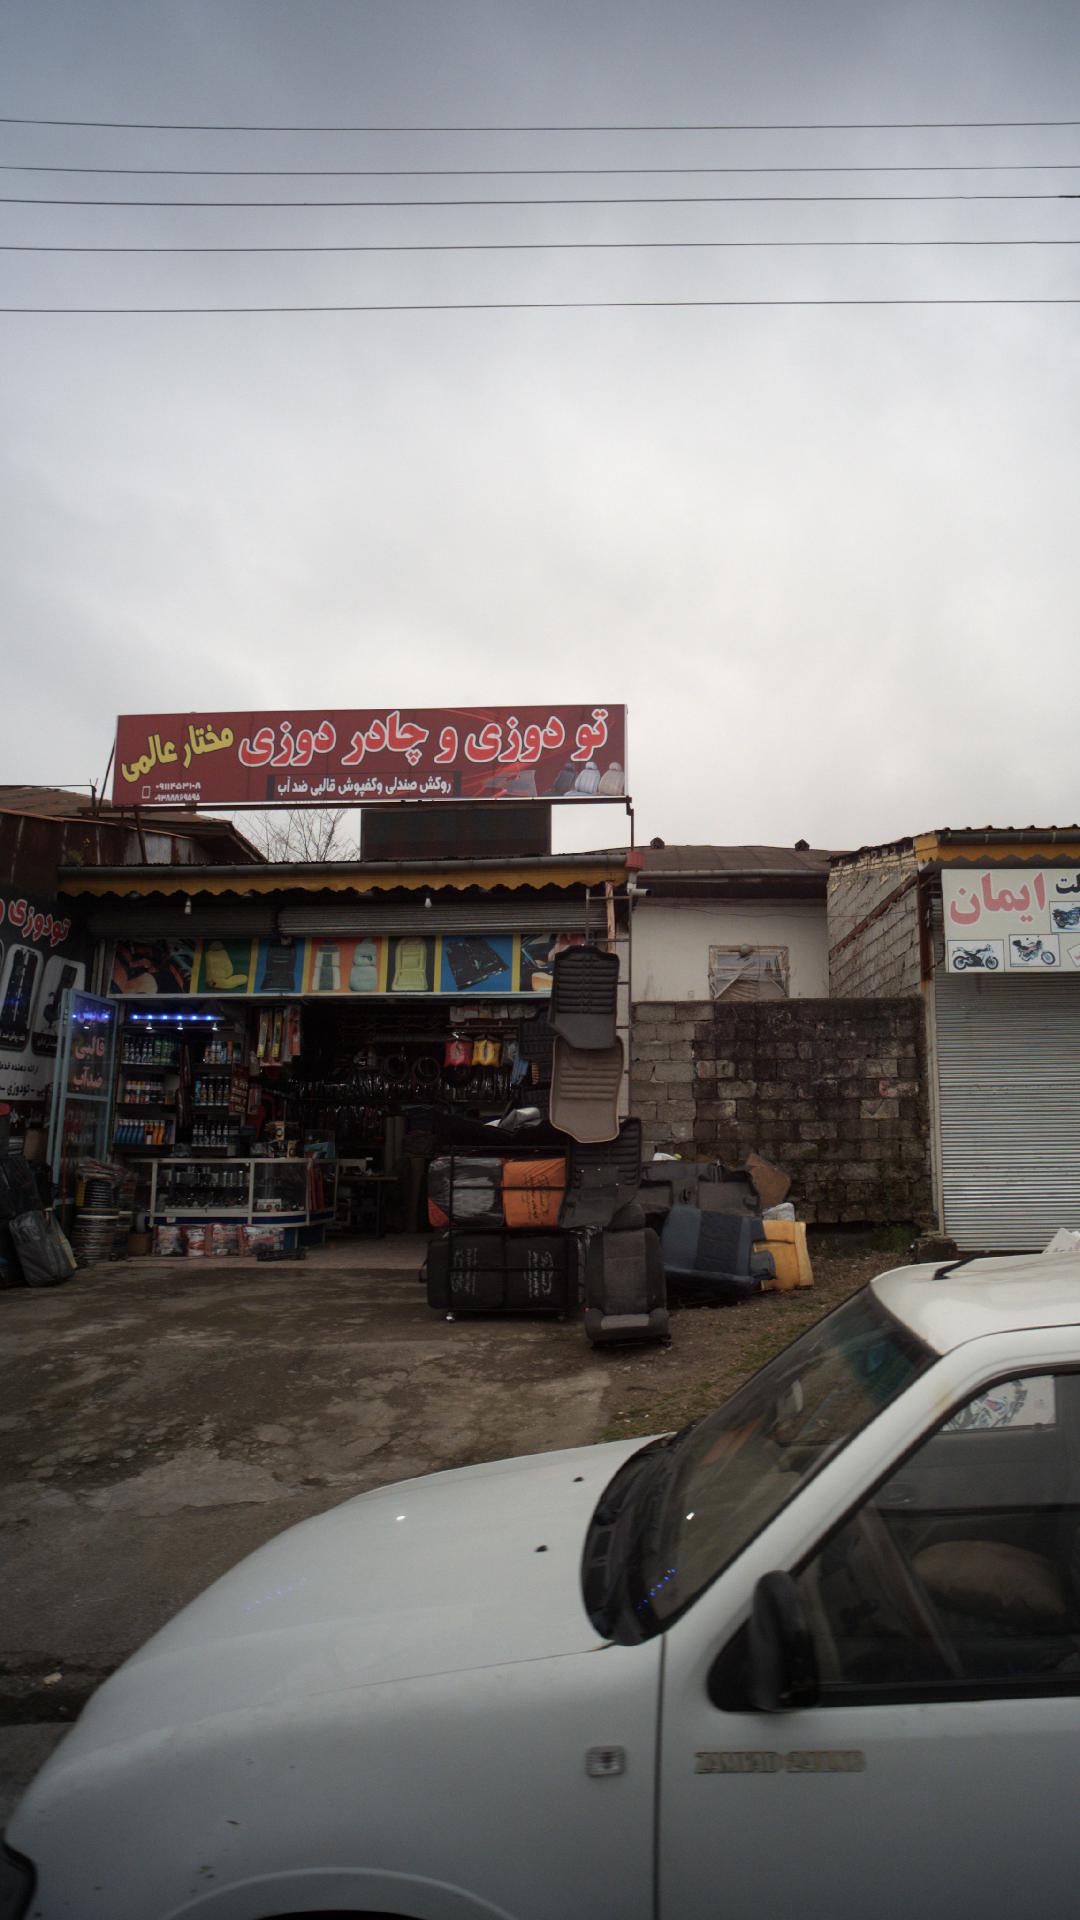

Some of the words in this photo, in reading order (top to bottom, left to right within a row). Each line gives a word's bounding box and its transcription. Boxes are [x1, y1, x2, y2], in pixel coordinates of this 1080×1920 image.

[121, 733, 178, 783] عالمی
[183, 724, 234, 768] مختار
[238, 720, 336, 767] دوزی
[341, 710, 429, 766] چادر
[434, 726, 458, 764] و
[465, 716, 565, 763] دوزی
[571, 709, 608, 761] تو
[310, 778, 336, 797] قالبی
[385, 776, 418, 795] صندلی
[419, 776, 452, 795] روکش
[950, 873, 1044, 924] ایمان
[8, 898, 71, 948] تودوزی
